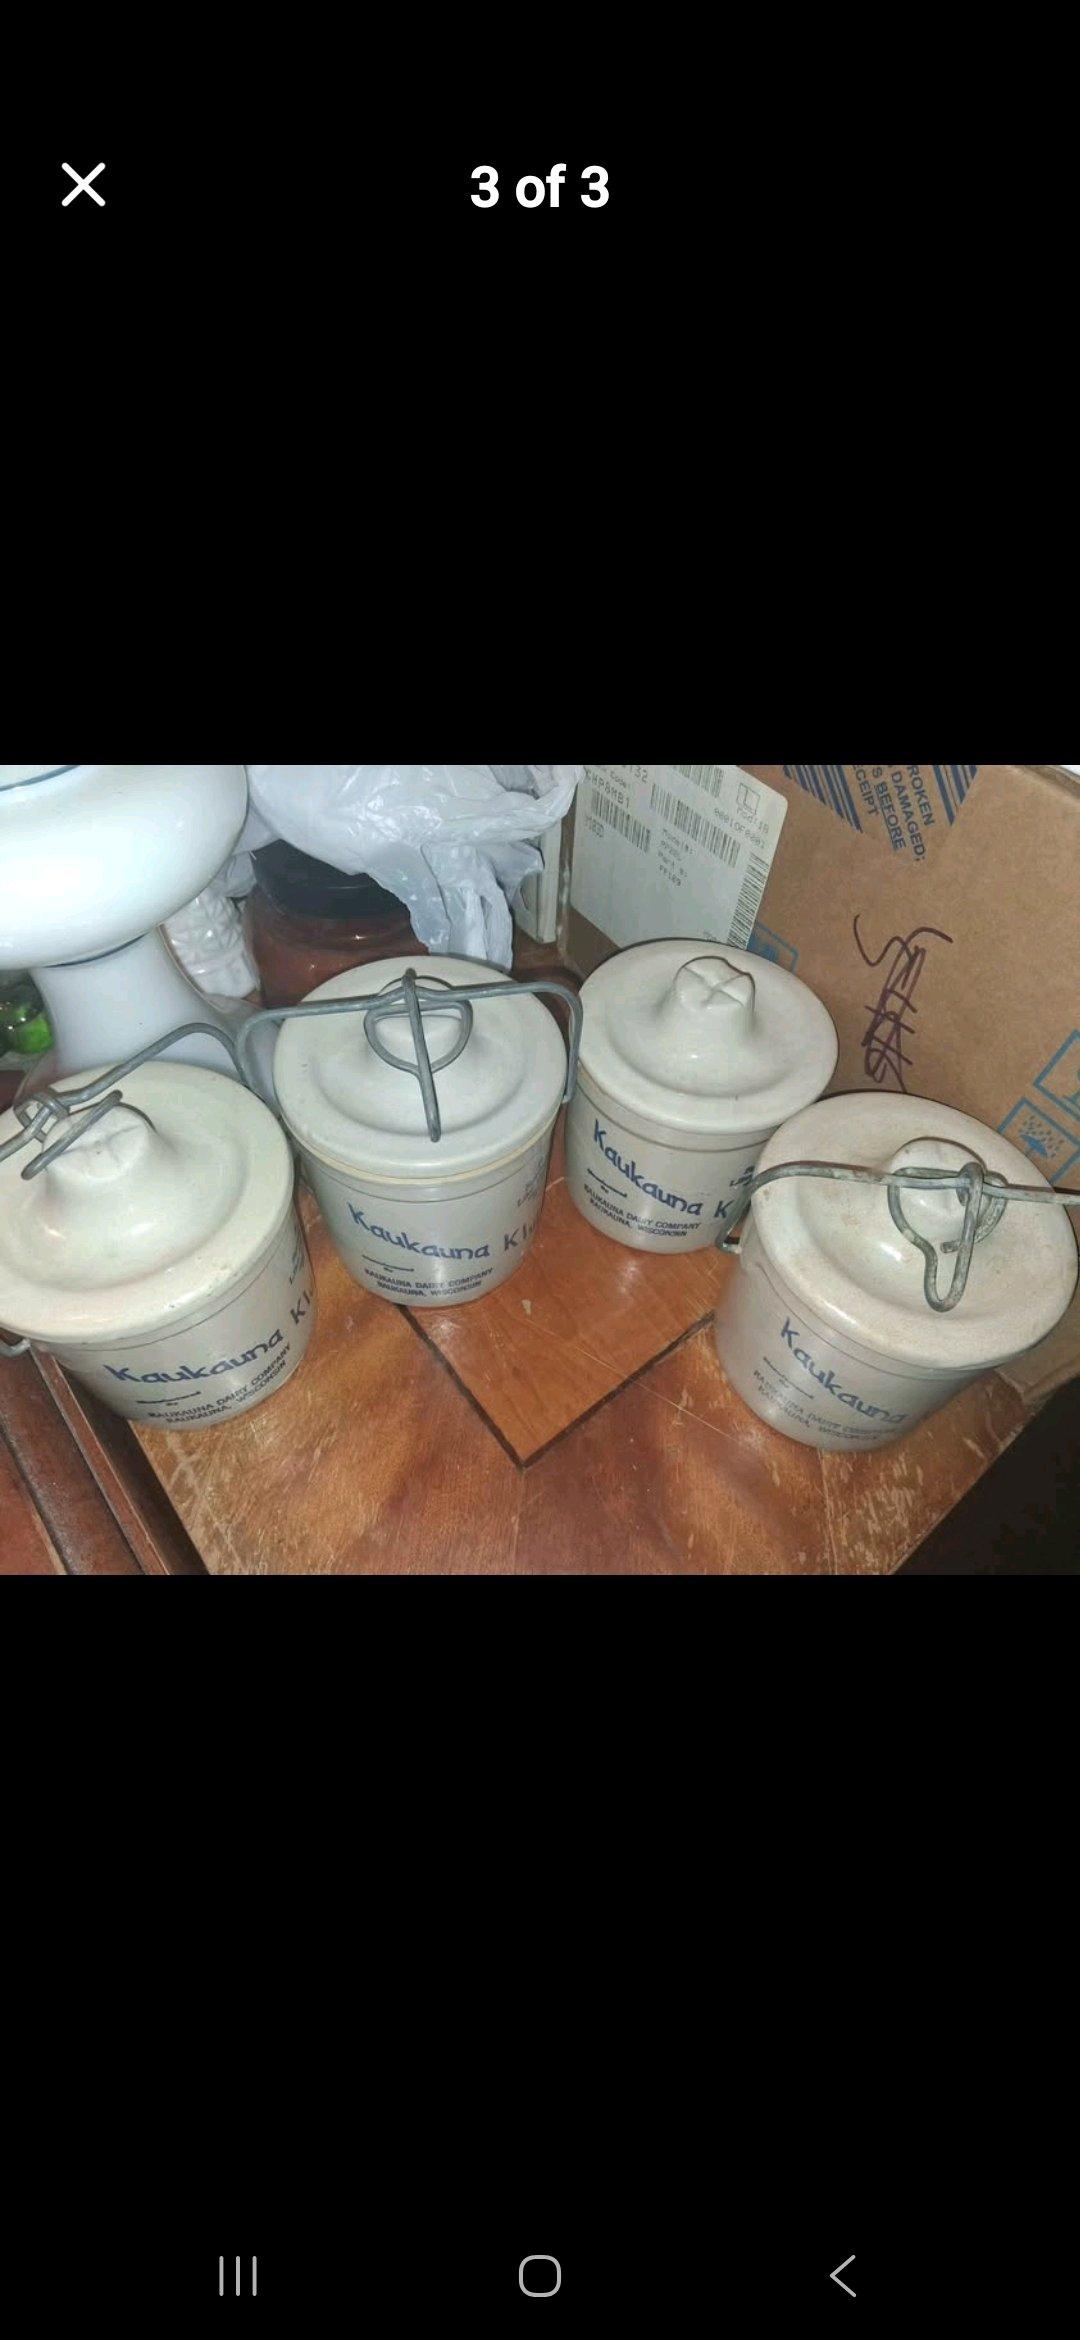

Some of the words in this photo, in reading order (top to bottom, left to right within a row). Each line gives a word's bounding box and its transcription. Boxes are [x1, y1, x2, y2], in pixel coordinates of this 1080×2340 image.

[876, 781, 907, 851] BEFORE
[593, 1118, 704, 1216] Kaukauna
[346, 1201, 491, 1260] Kaukauna
[101, 1328, 284, 1384] Kaukauna
[216, 1384, 248, 1407] DAIRY
[250, 1342, 291, 1386] COMPANY
[781, 1316, 911, 1425] Kaukauna
